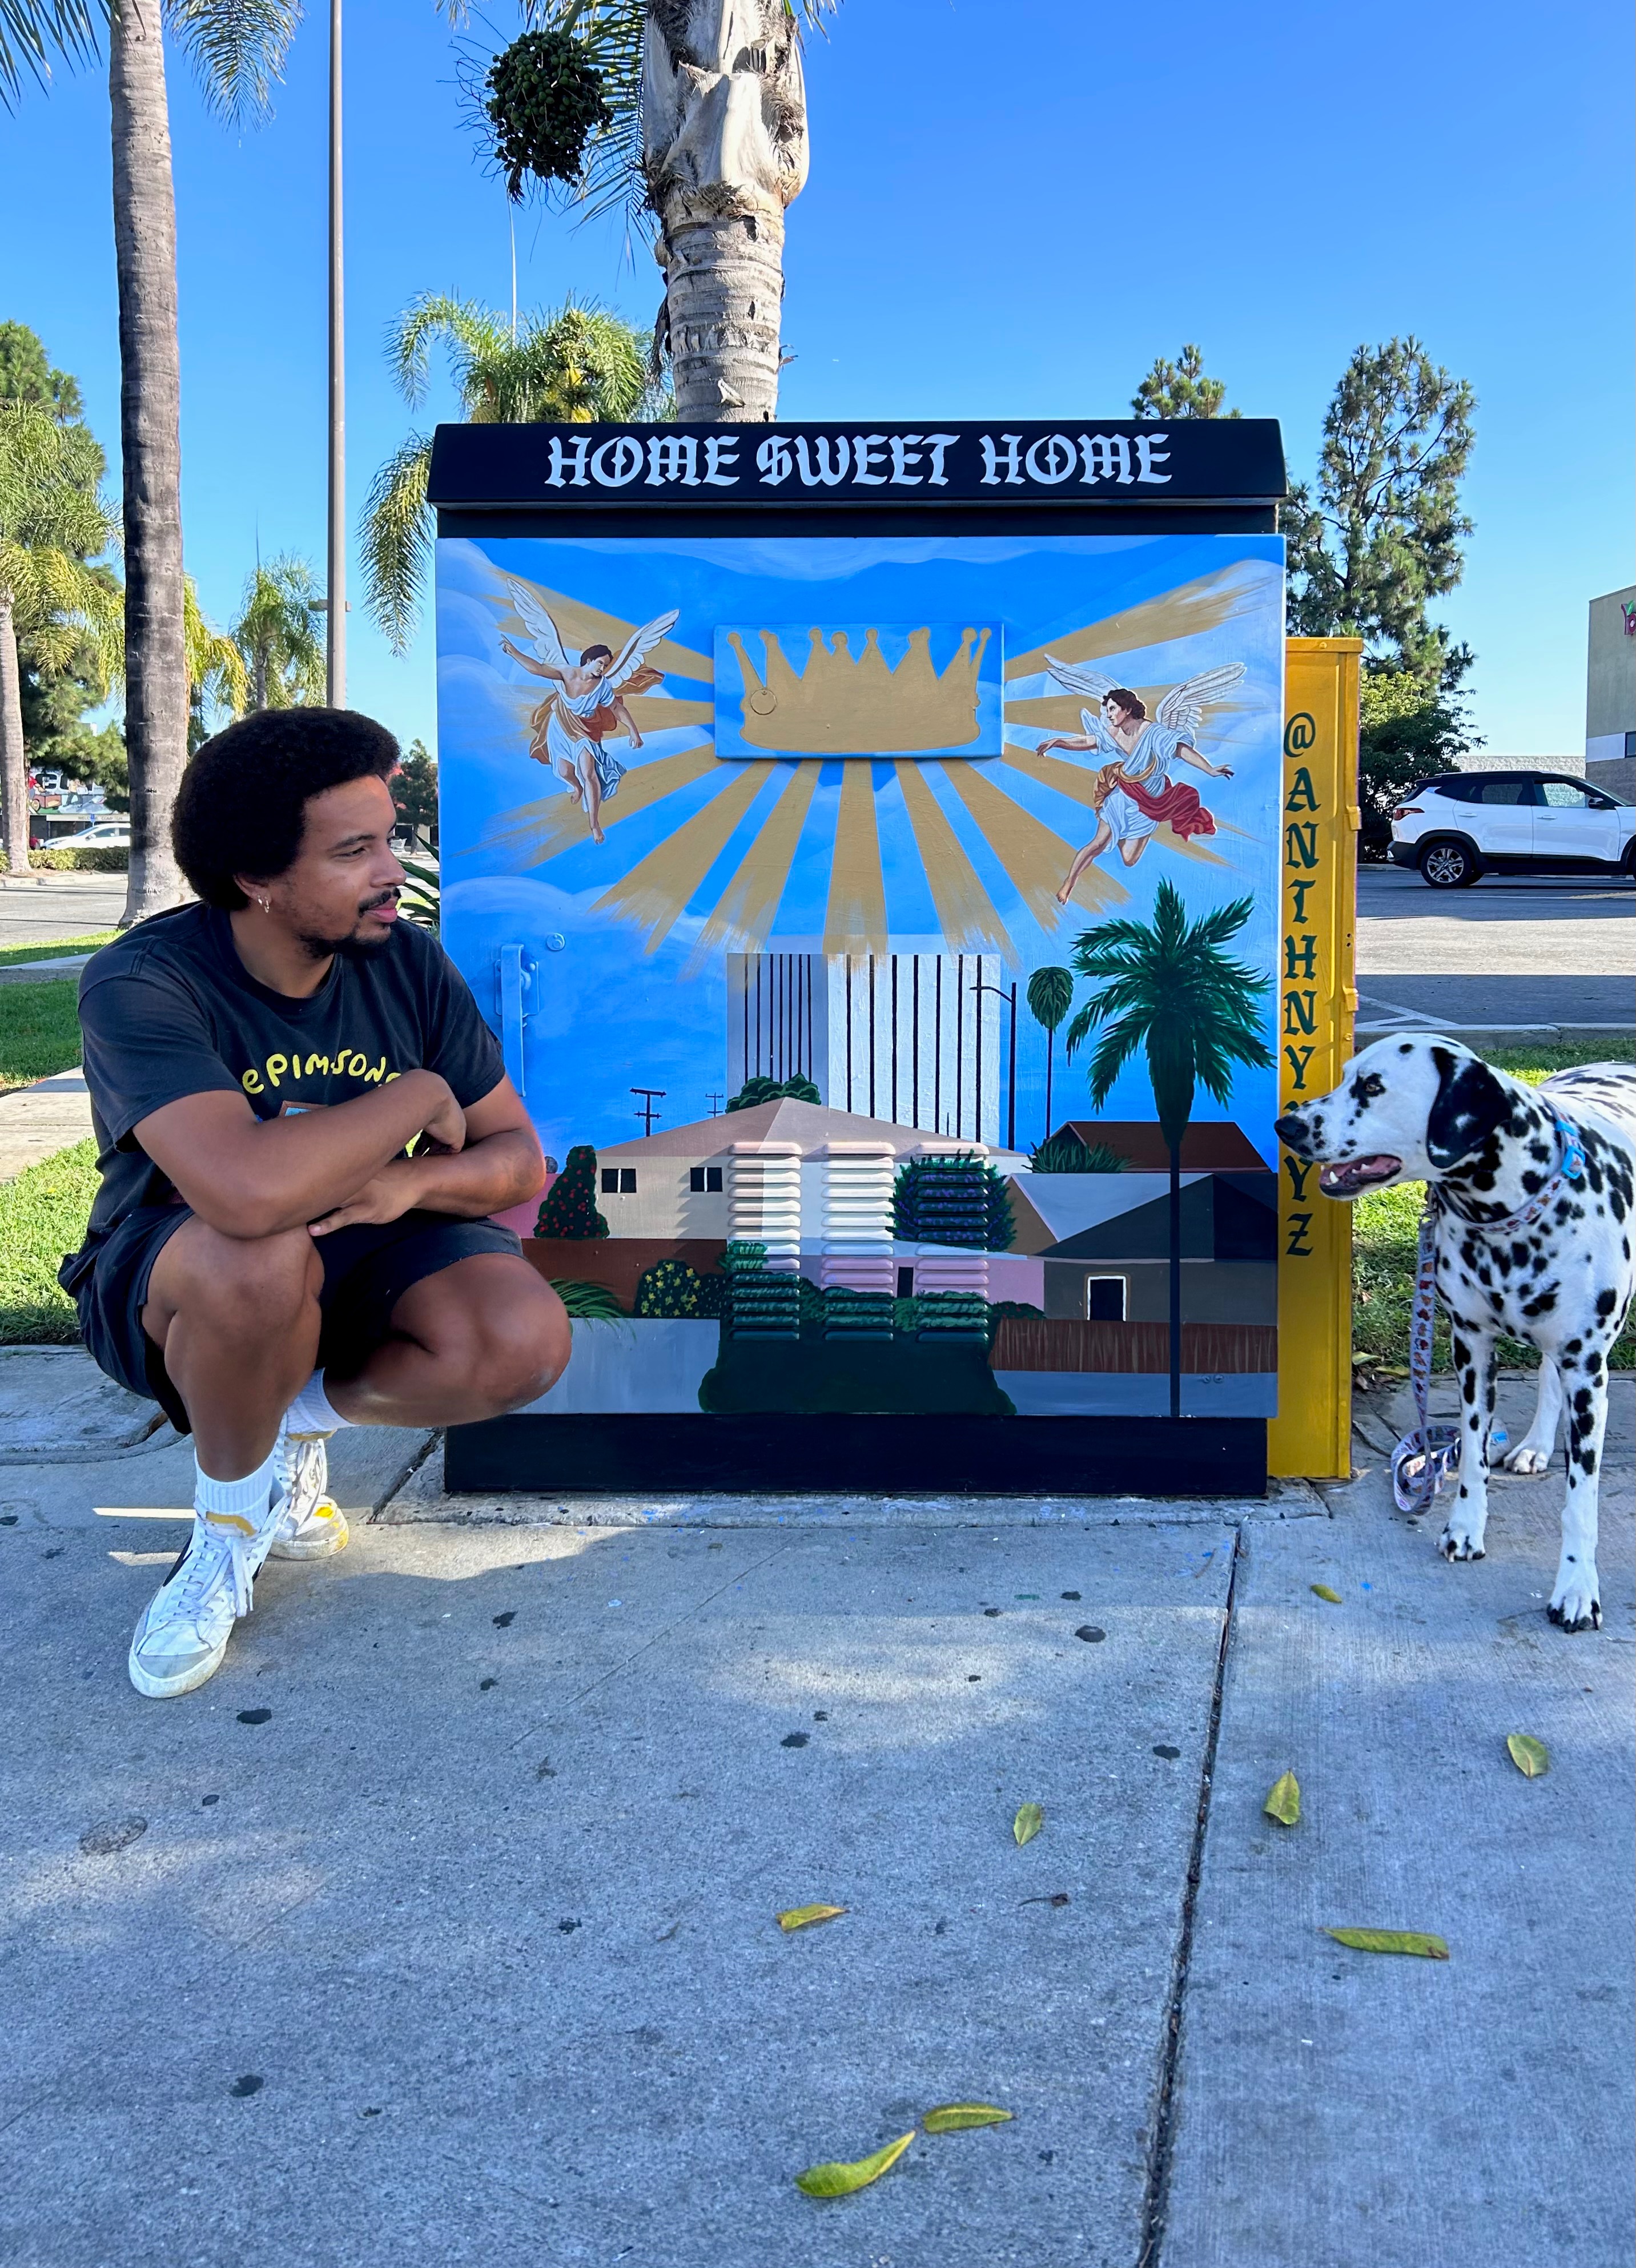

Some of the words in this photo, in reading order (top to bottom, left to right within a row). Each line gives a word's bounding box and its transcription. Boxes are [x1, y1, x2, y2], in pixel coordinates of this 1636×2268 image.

[544, 435, 740, 488] HOME
[756, 433, 961, 486] SWEET
[978, 433, 1172, 485] HOME
[1283, 712, 1321, 1256] @ANTHNYYZ
